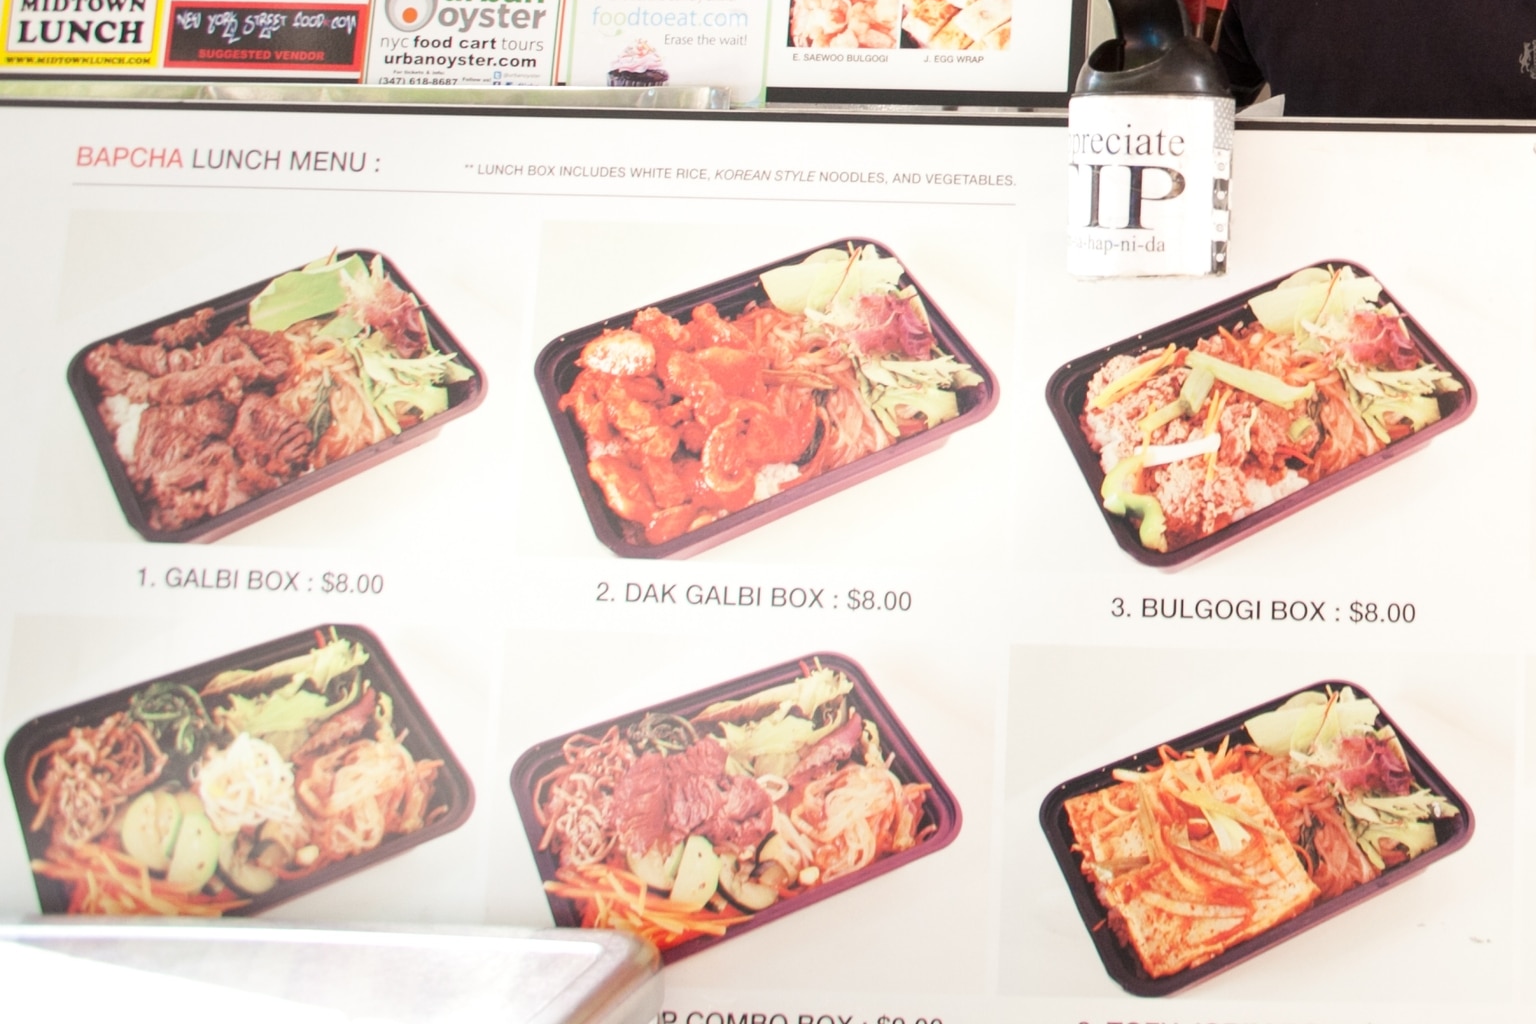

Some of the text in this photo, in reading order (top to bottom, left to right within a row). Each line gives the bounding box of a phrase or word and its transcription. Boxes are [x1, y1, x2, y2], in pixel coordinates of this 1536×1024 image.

[438, 4, 547, 33] oyster
[592, 7, 749, 29] foodtoeat.com
[18, 20, 144, 43] LUNCH
[664, 34, 748, 47] Erase the wait!
[198, 48, 325, 61] SUGGESTED VENDOR
[380, 35, 544, 52] nyc food cart tours
[384, 52, 537, 70] urbanoyster.com
[934, 55, 954, 63] EGG
[956, 55, 985, 64] WRAP
[76, 146, 183, 168] BAPCHA
[192, 148, 281, 170] LUNCH
[289, 150, 367, 173] MENU
[477, 164, 524, 176] LUNCH
[527, 165, 556, 176] BOX
[559, 165, 626, 178] INCLUDES
[630, 167, 672, 179] WHITE
[676, 168, 710, 181] RICE,
[714, 169, 772, 181] KOREAN
[774, 170, 816, 182] STYLE
[819, 171, 888, 184] NOODLES,
[892, 173, 922, 184] AND
[925, 173, 1016, 186] VEGETABLES.
[138, 567, 155, 587] 1.
[164, 566, 239, 589] GALBI
[247, 570, 300, 591] BOX
[321, 571, 384, 594] $8.00
[596, 582, 615, 602] 2.
[625, 582, 676, 604] DAK
[686, 584, 761, 606] GALBI
[771, 587, 824, 608] BOX
[847, 588, 912, 611] $8.00
[1111, 597, 1131, 617] 3.
[1142, 598, 1261, 620] BULGOGI
[1271, 601, 1325, 621] BOX
[1349, 601, 1416, 623] $8.00
